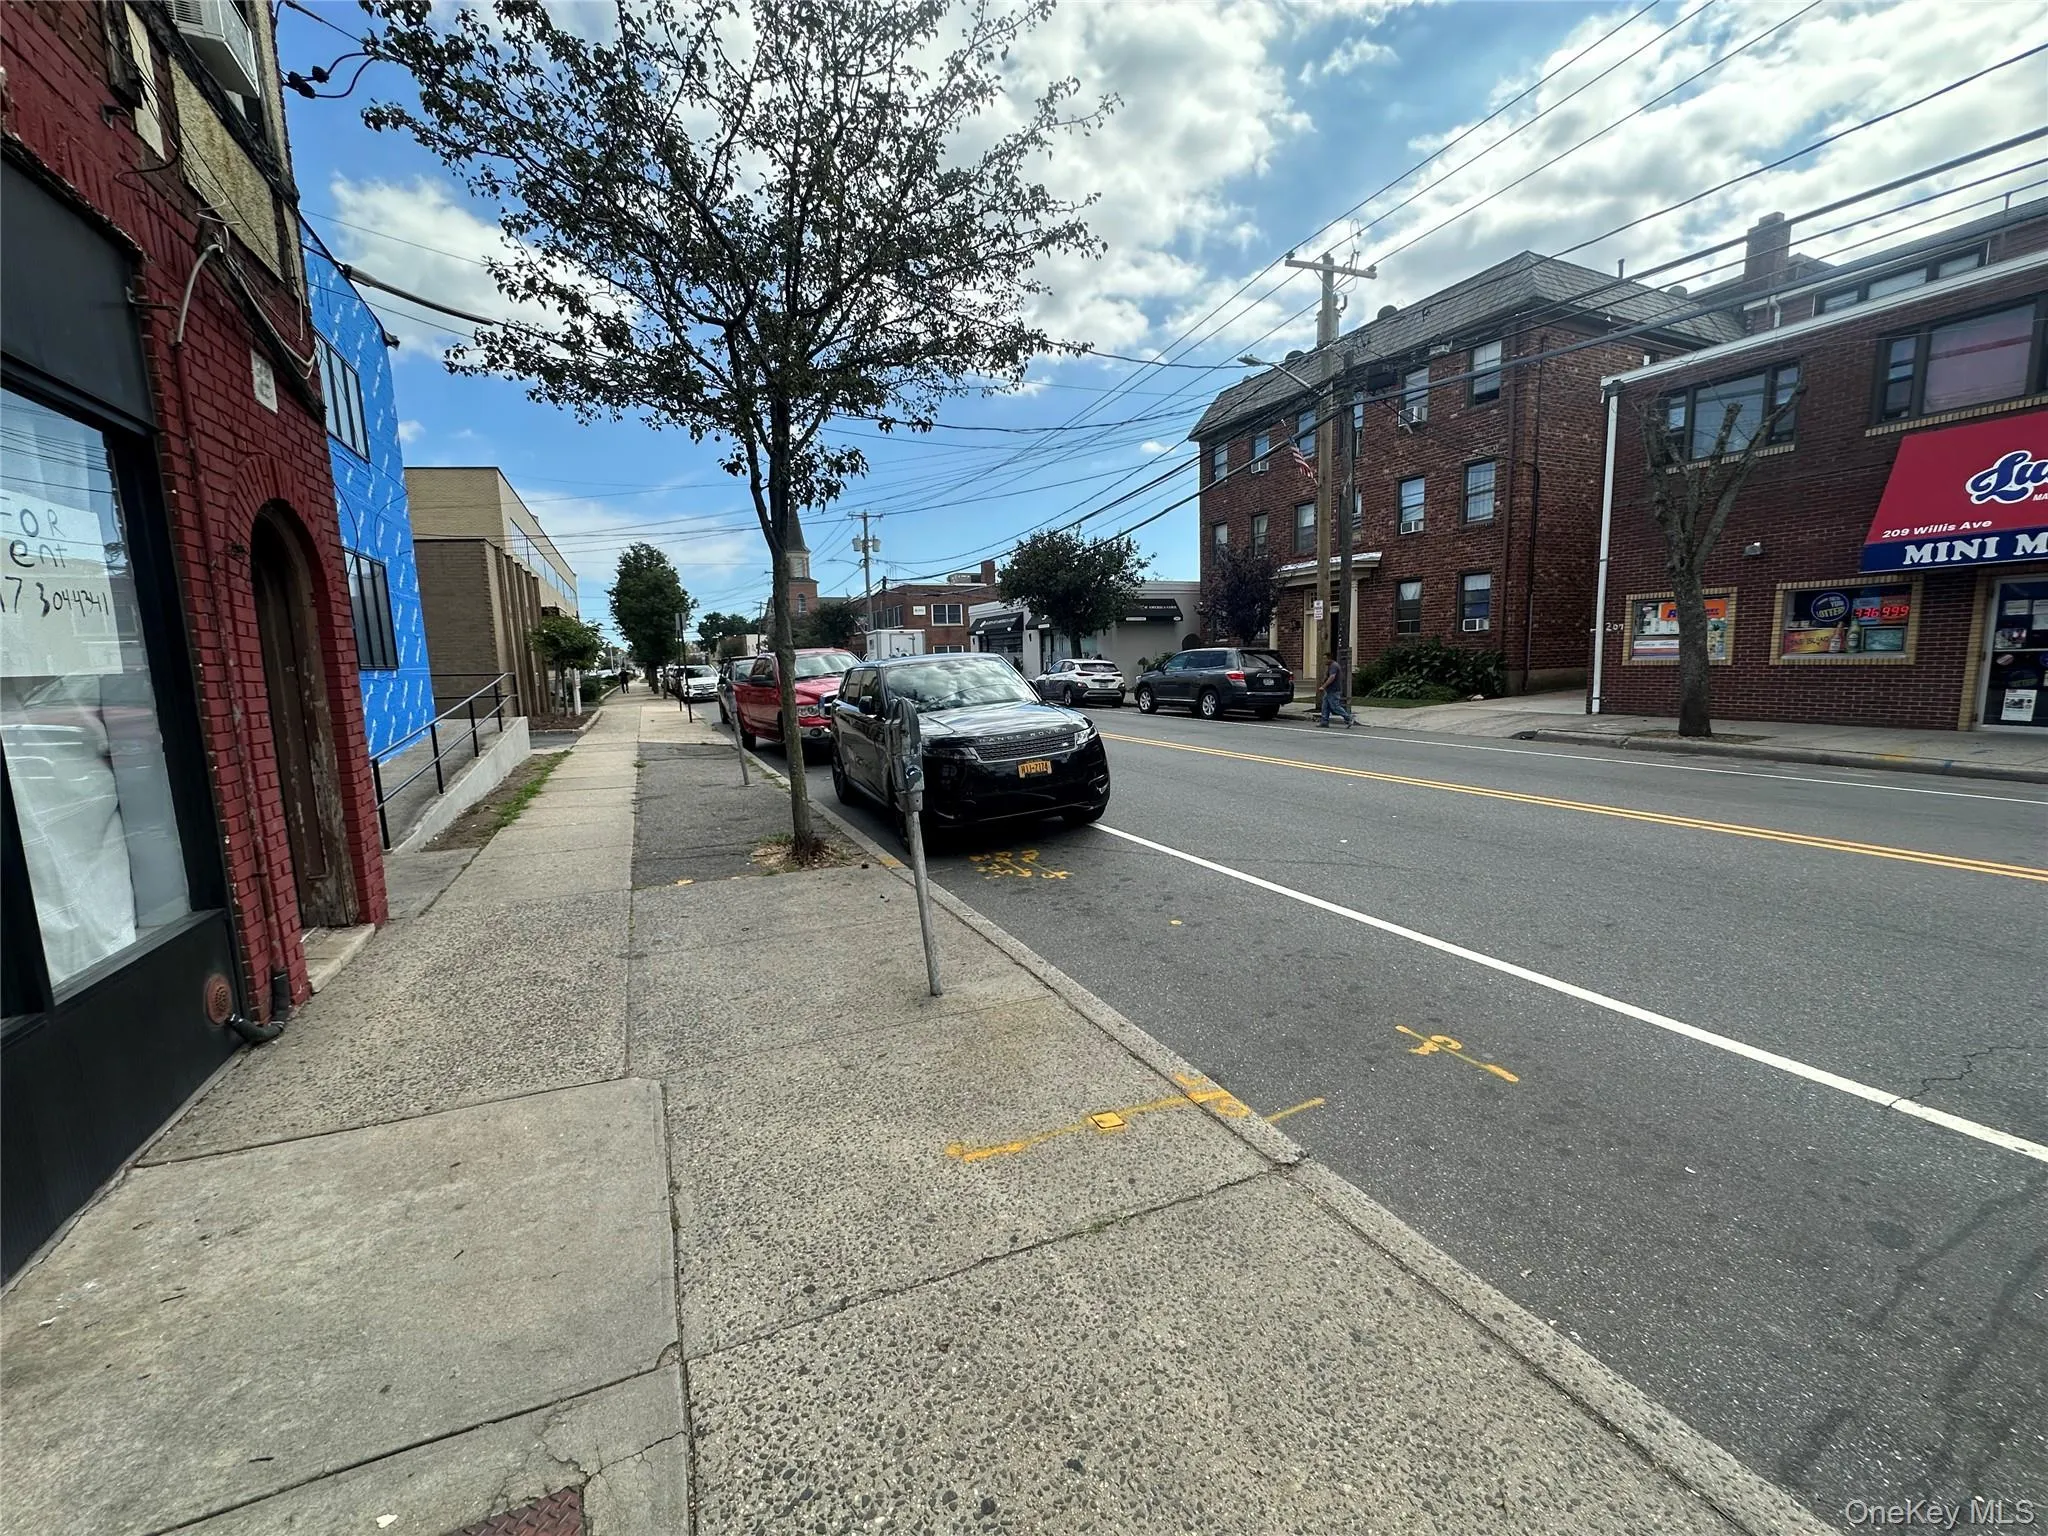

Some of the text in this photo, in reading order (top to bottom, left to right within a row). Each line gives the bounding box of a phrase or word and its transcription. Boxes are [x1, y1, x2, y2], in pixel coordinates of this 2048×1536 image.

[1882, 519, 1993, 539] 209 Willis Ave
[1902, 536, 2000, 566] MINI
[1604, 621, 1625, 632] 207
